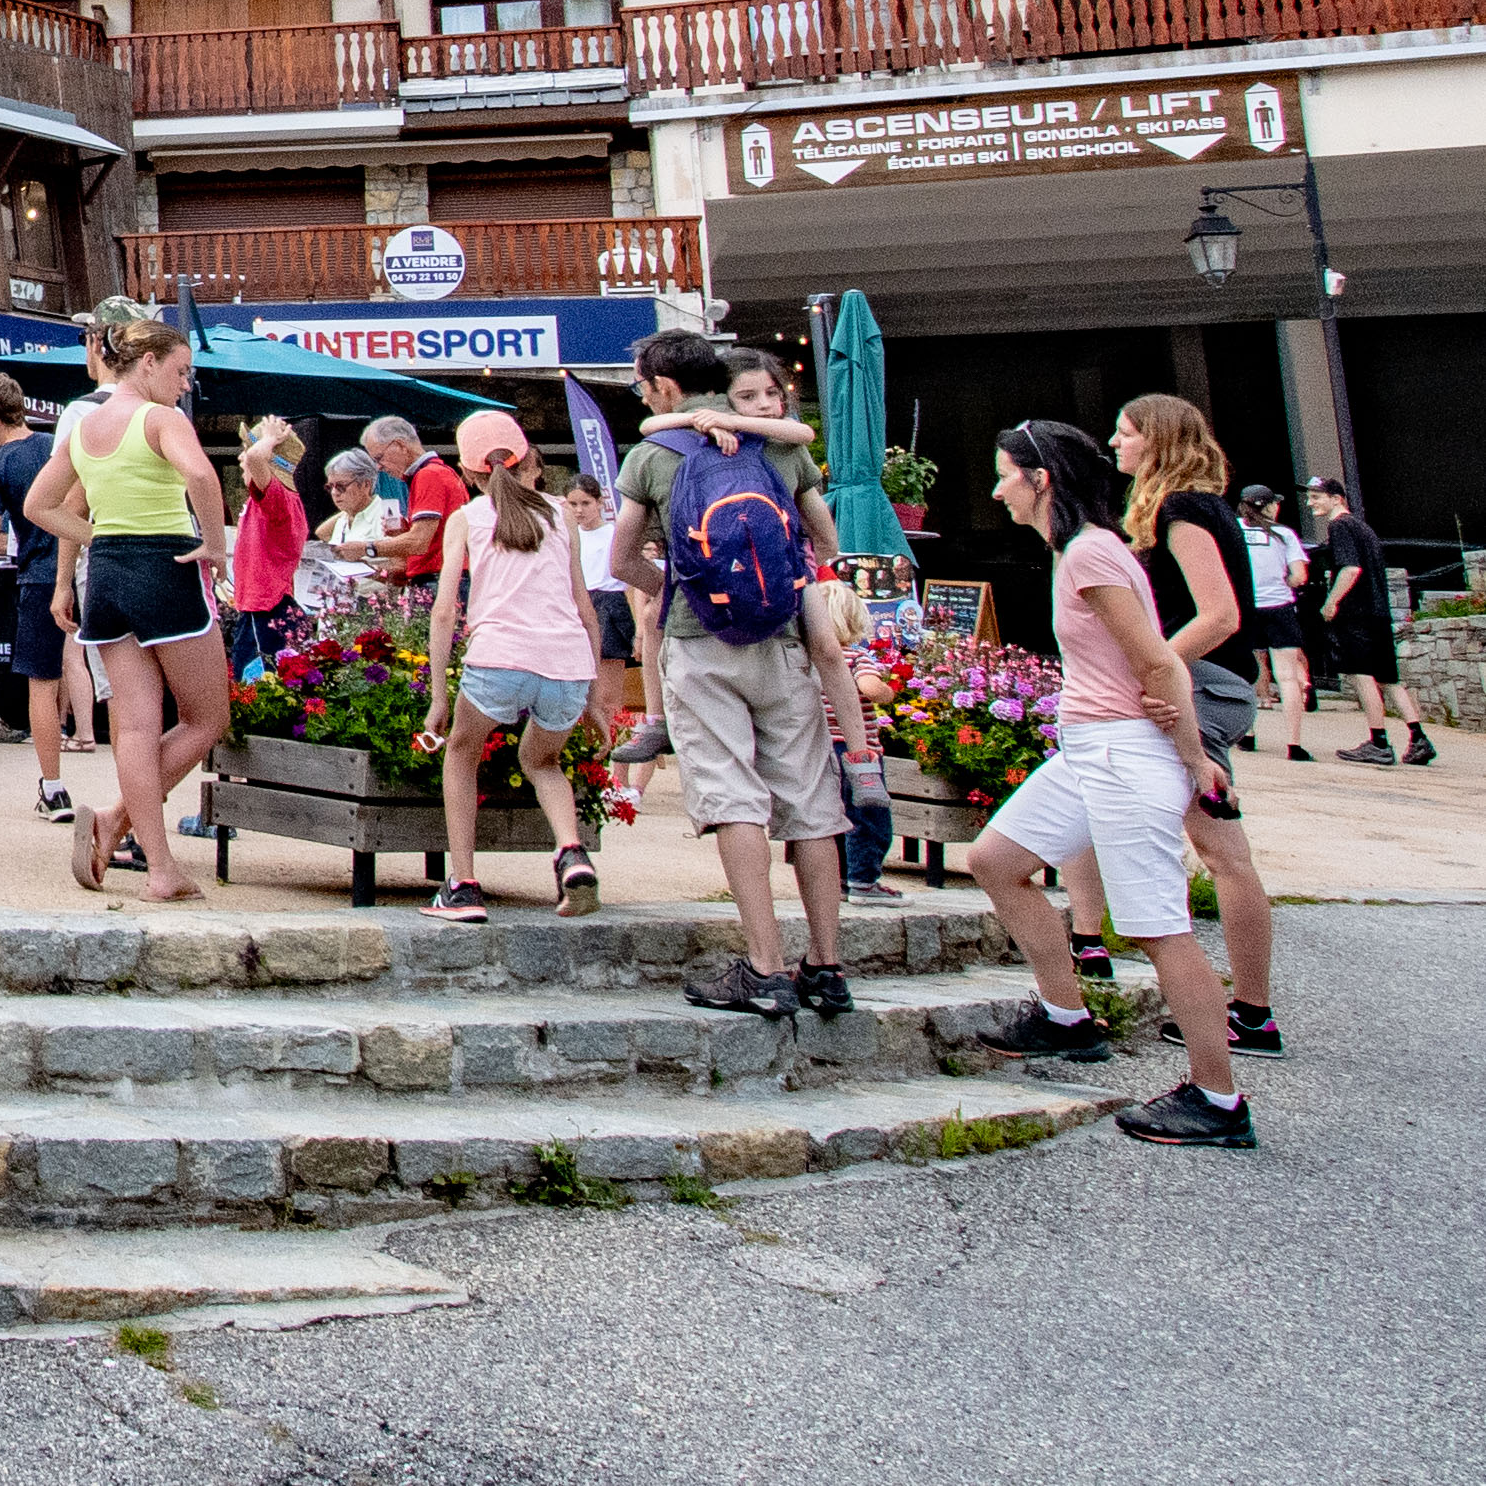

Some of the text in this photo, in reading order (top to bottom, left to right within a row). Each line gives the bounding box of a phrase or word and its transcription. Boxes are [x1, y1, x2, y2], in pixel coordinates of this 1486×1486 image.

[792, 101, 1078, 144] ASCENSEUR
[1120, 89, 1222, 119] LIFT
[1023, 116, 1227, 143] GONDOLA SKI PASS
[792, 133, 1007, 160] TÉLÉCABINE FORFAITS
[1025, 141, 1141, 161] SKI SCHOOL
[887, 150, 1009, 170] ÉCOLE DE SKI
[391, 256, 458, 268] A VENDRE
[391, 273, 404, 282] 04
[405, 273, 418, 282] 79
[303, 328, 546, 360] INTERSPORT
